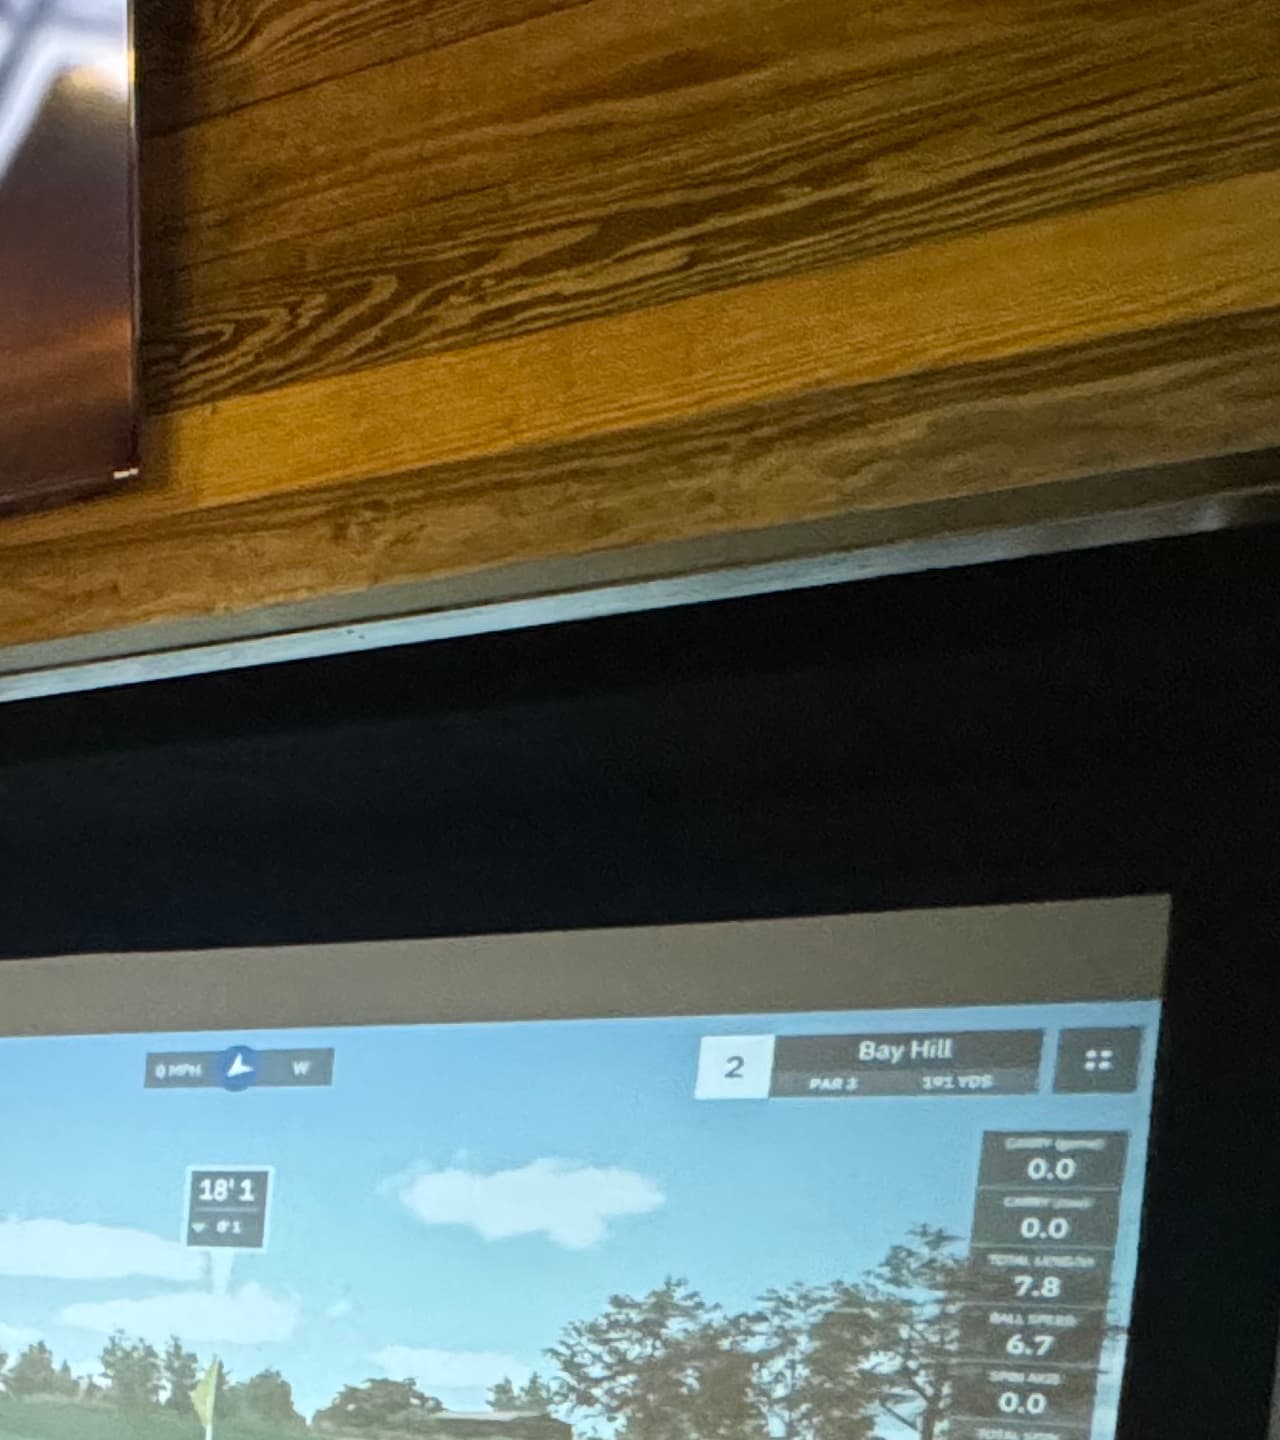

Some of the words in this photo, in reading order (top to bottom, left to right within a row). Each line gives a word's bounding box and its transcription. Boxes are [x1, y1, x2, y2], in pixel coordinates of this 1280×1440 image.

[859, 1040, 905, 1064] Bay
[911, 1038, 953, 1060] Hill
[292, 1061, 312, 1076] W
[724, 1056, 745, 1079] 2
[809, 1077, 843, 1091] PAR
[957, 1074, 993, 1089] YDS
[1027, 1158, 1076, 1180] 0.0
[1020, 1217, 1069, 1239] 0.0
[1014, 1275, 1061, 1298] 7.8
[1006, 1334, 1055, 1356] 6.7
[998, 1392, 1047, 1415] 0.0
